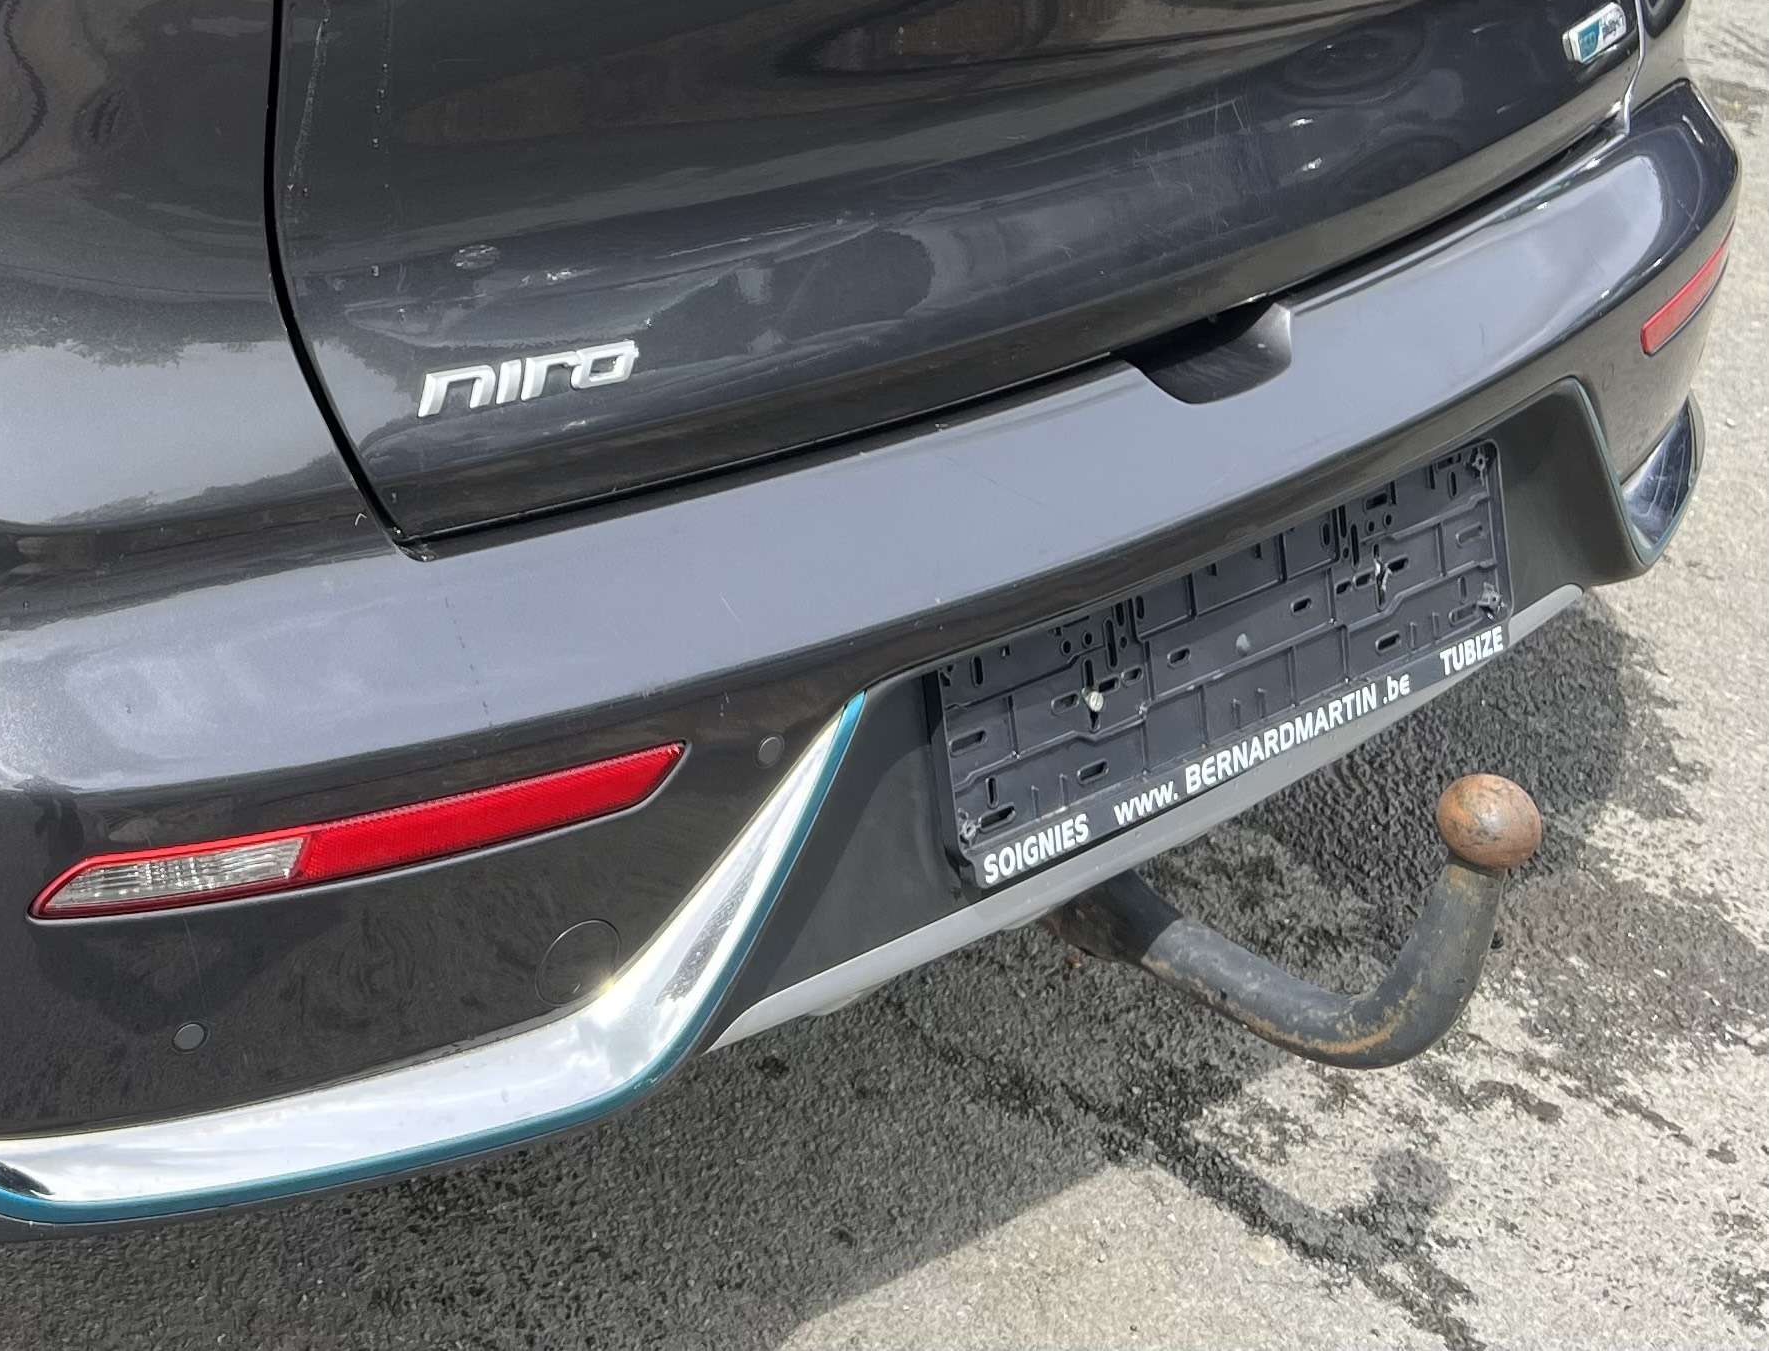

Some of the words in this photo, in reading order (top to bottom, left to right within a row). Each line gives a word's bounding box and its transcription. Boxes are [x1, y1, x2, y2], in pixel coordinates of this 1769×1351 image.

[417, 339, 640, 418] niro
[983, 813, 1090, 884] SOIGNIES
[1185, 682, 1378, 795] BERNARDMARTIN
[1439, 625, 1504, 676] TUBIZE
